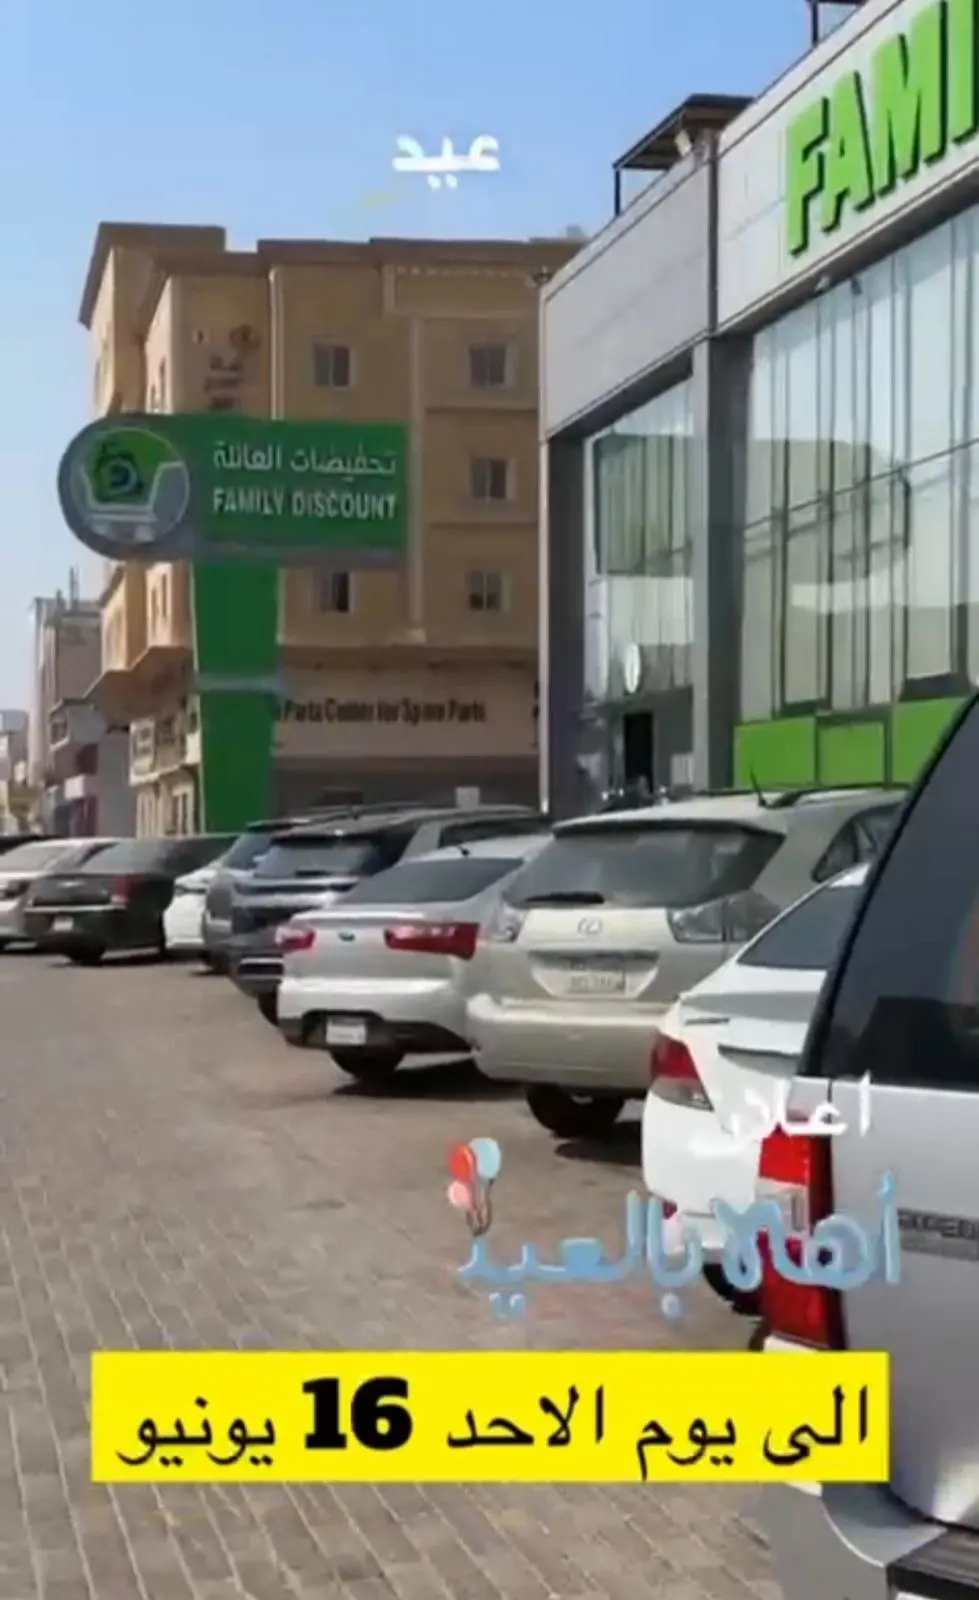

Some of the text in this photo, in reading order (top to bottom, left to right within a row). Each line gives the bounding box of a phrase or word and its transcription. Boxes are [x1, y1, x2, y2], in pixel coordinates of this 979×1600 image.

[786, 0, 979, 258] FAMI
[213, 486, 397, 520] FAMILY DISCOUNT
[448, 699, 488, 723] Parts
